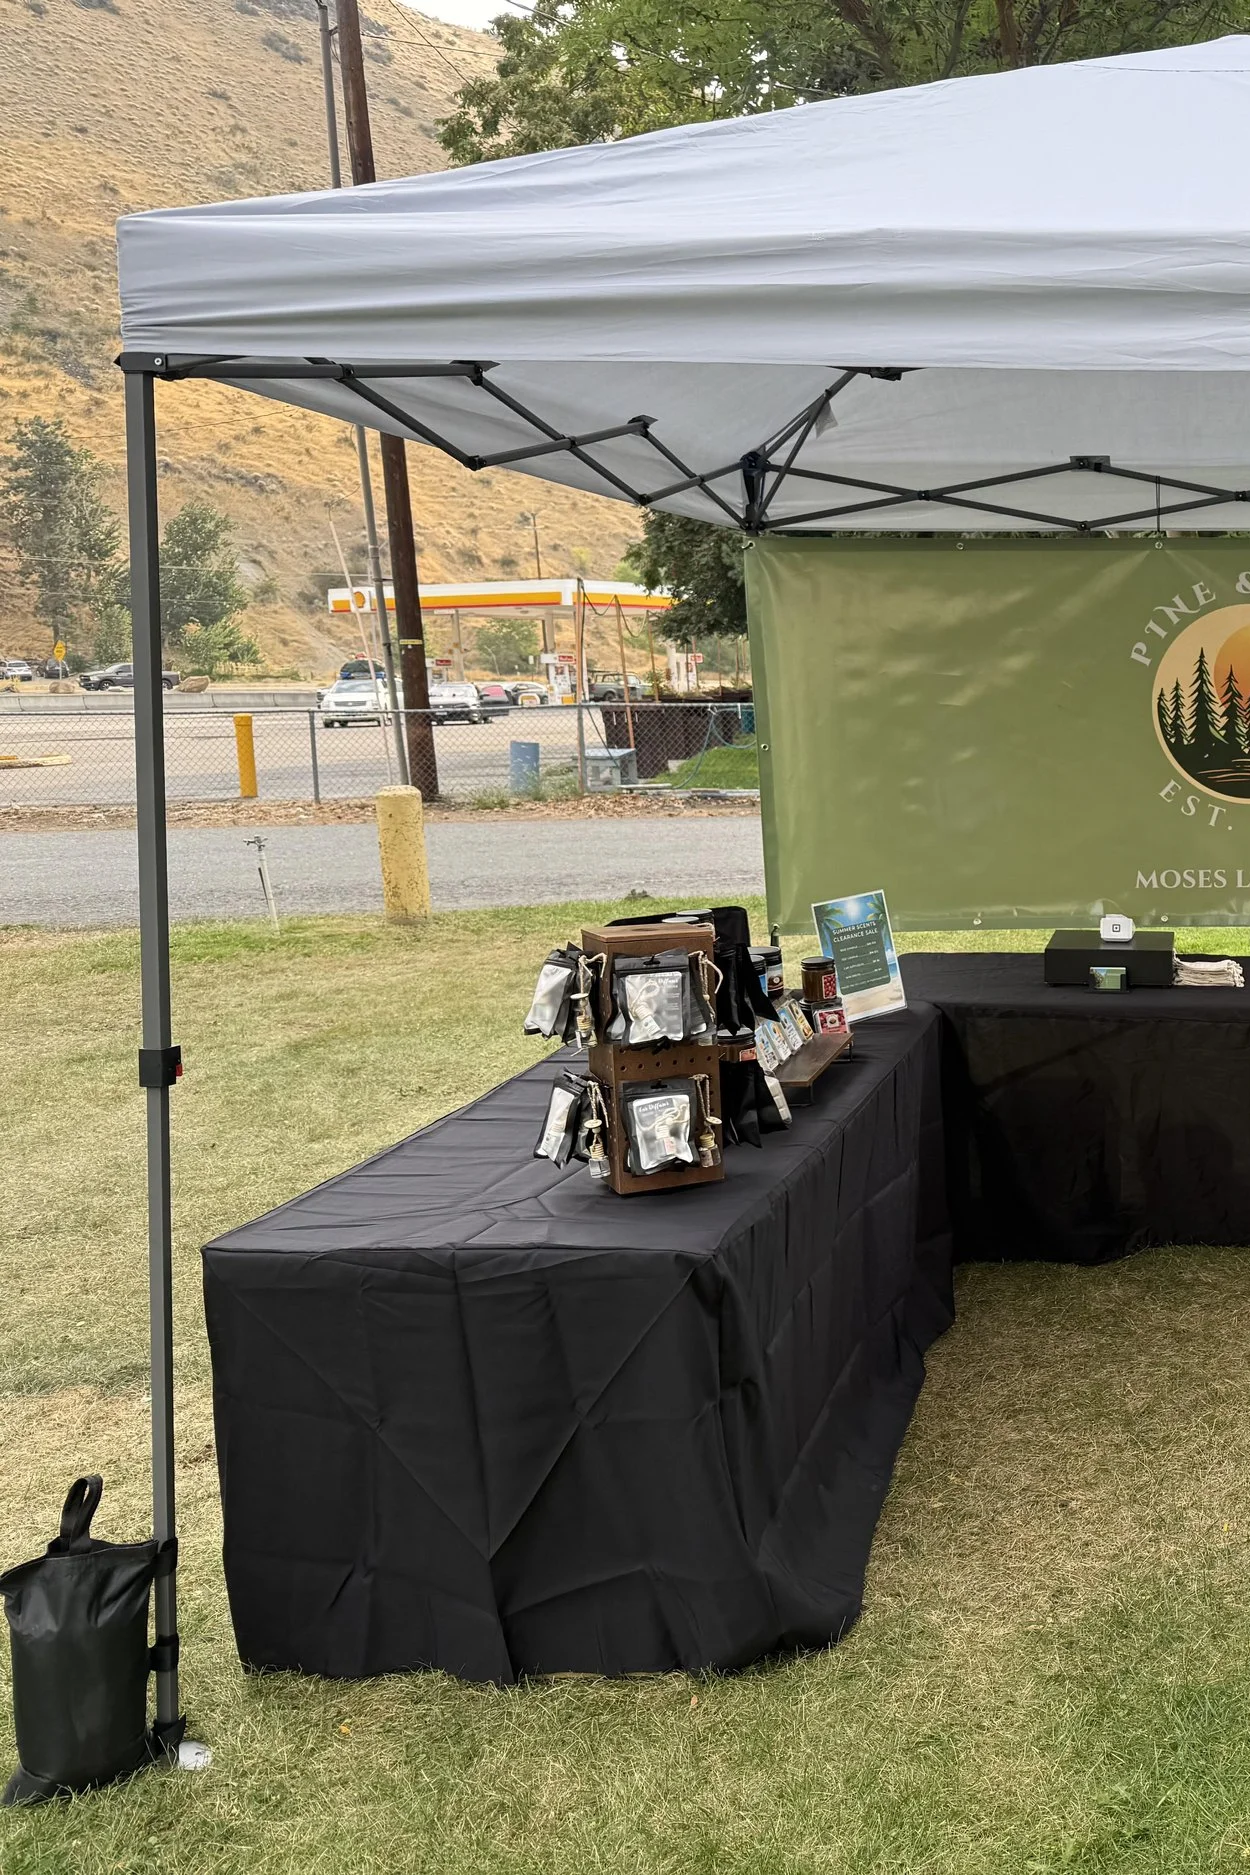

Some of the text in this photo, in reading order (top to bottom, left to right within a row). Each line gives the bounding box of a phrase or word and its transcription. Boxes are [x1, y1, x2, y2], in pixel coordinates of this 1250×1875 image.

[1130, 580, 1217, 667] PINE
[1158, 778, 1233, 831] EST.
[1135, 869, 1227, 889] MOSES
[832, 921, 876, 935] SUMMER SCENTS
[833, 927, 878, 943] CLEARANCE SALE
